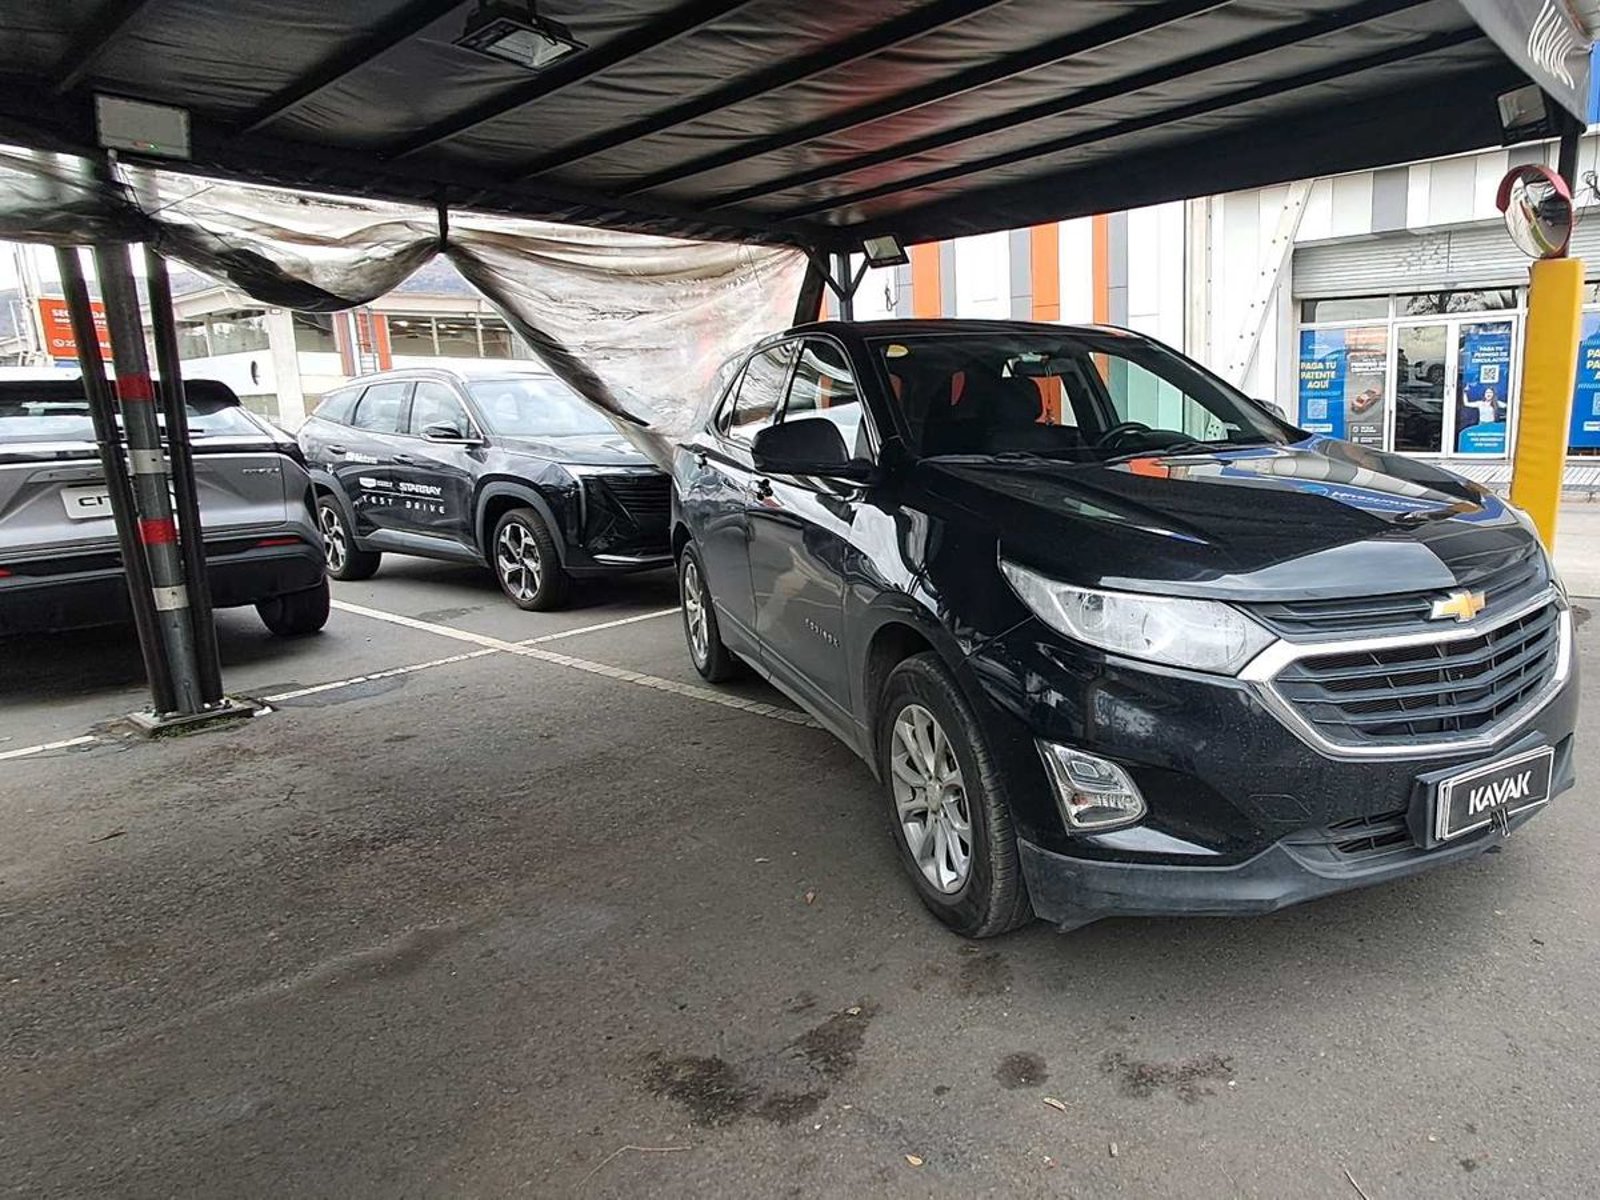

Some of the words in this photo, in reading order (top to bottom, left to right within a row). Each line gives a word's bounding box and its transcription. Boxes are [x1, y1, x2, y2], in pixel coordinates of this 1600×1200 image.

[1301, 361, 1324, 370] PAGA
[1325, 361, 1337, 370] TU
[1301, 370, 1336, 380] PATENTE
[362, 495, 393, 506] TEST
[406, 501, 445, 514] DRIVE
[1468, 770, 1532, 815] KAVAK
